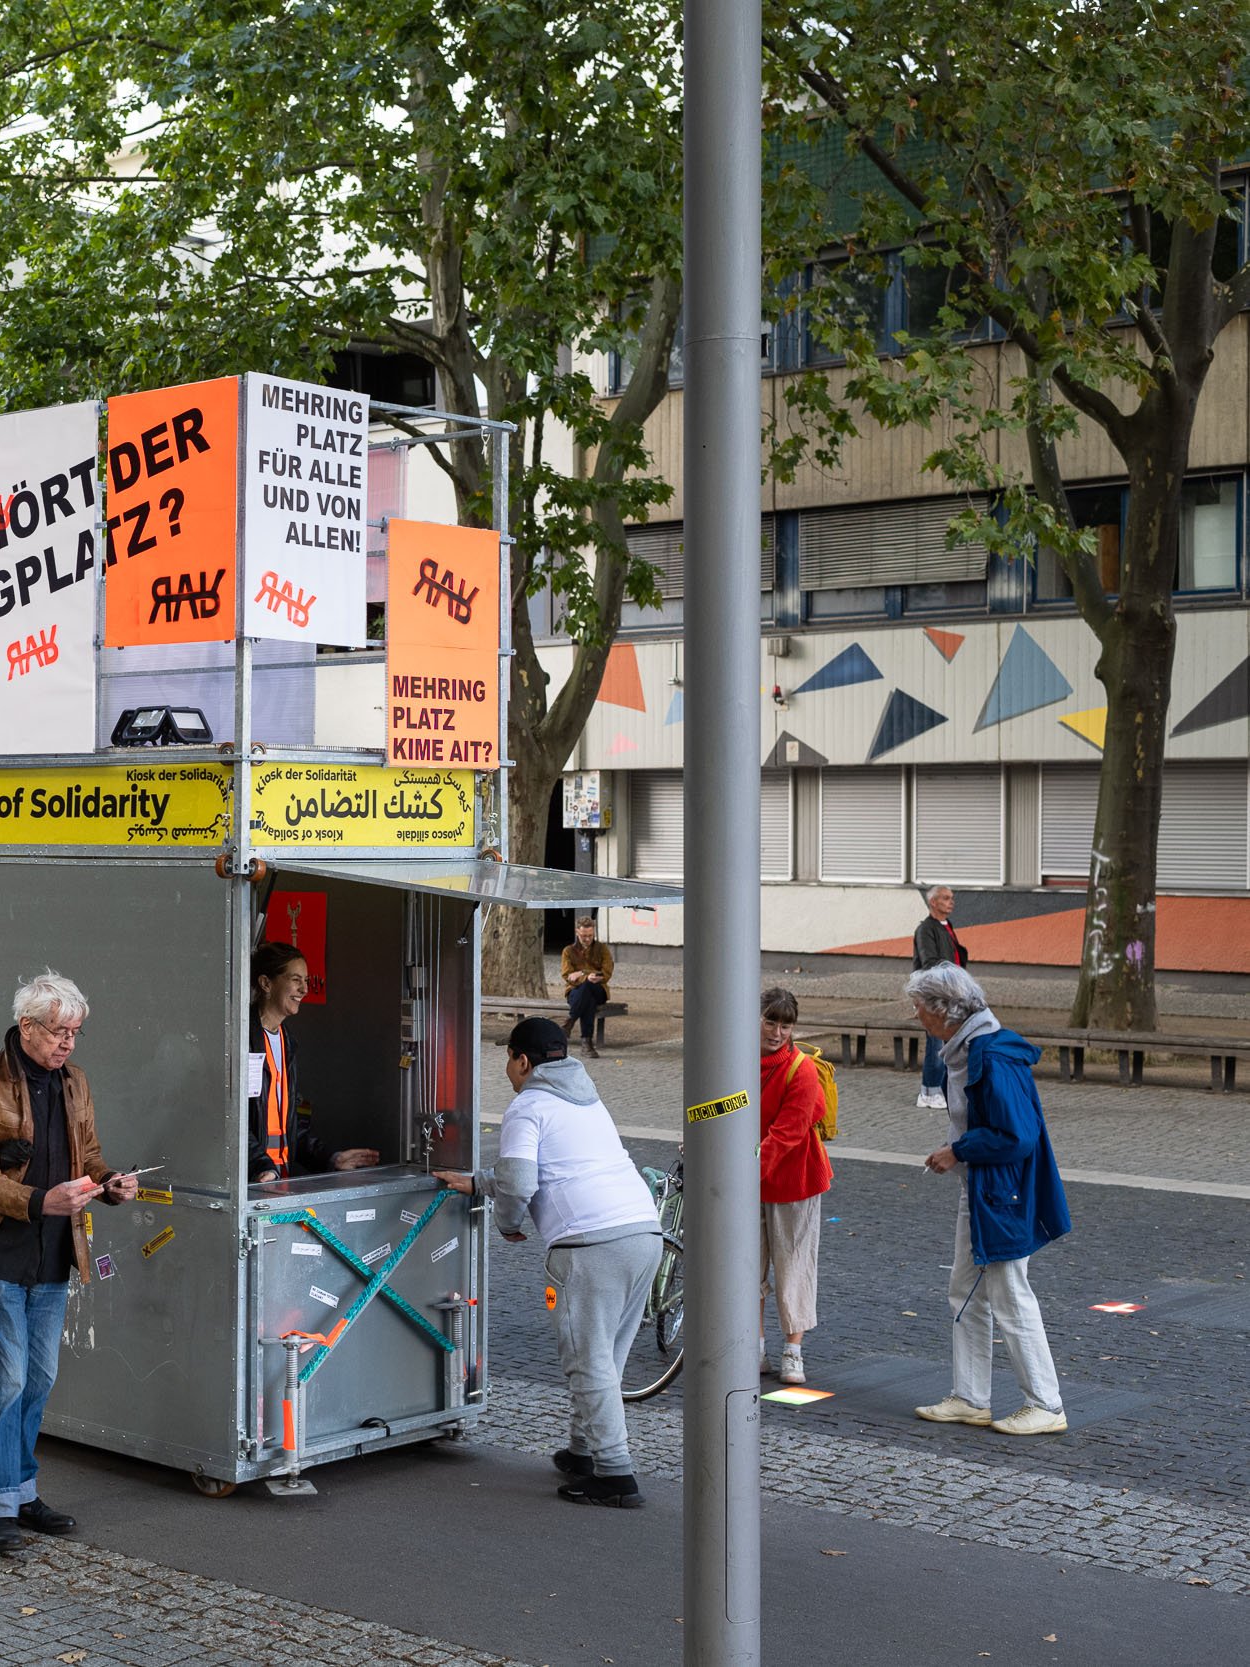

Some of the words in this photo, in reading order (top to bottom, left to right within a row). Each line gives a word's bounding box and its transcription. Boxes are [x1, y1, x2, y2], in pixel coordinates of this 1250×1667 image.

[262, 383, 363, 424] MEHRING
[109, 407, 211, 494] DER
[296, 423, 362, 457] PLATZ
[258, 447, 302, 480] FÜR
[309, 459, 362, 489] ALLE
[263, 484, 310, 513] UND
[316, 492, 361, 521] VON
[285, 521, 361, 553] ALLEN!
[392, 675, 486, 702] MEHRING
[393, 706, 455, 731] PLATZ
[392, 737, 444, 762] KIME
[449, 739, 493, 763] AIT?
[126, 769, 155, 782] Kiosk
[158, 769, 178, 781] der
[255, 768, 283, 796] Kiosk
[285, 768, 303, 781] der
[305, 769, 358, 782] Solidarität
[30, 784, 171, 826] Solidarity
[285, 788, 377, 827] التضامن
[301, 828, 313, 841] of
[315, 828, 343, 842] Kiosk
[432, 821, 466, 842] chiosco
[688, 1104, 716, 1123] MACH
[723, 1094, 748, 1112] ONE
